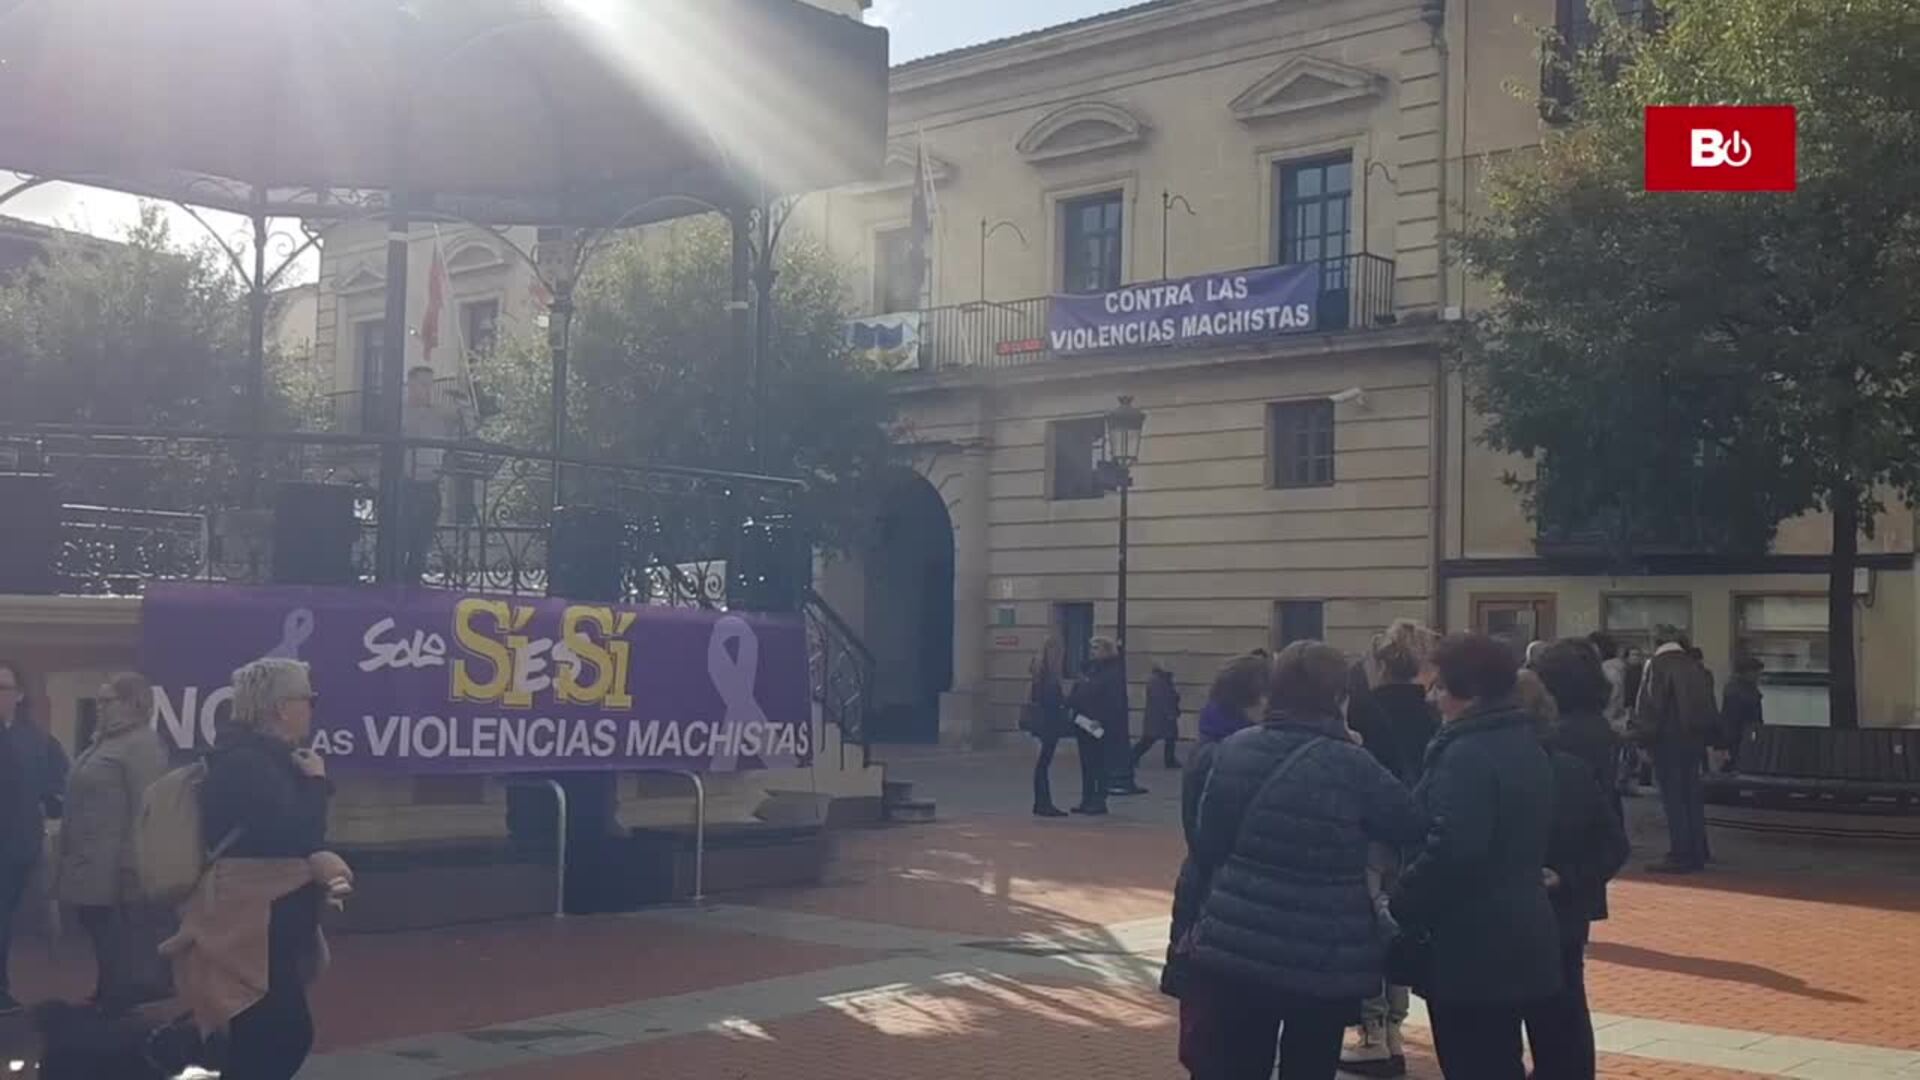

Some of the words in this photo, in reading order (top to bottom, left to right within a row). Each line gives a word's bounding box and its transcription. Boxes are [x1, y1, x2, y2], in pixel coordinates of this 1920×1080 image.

[1105, 283, 1194, 313] CONTRA
[1206, 276, 1248, 301] LAS
[1051, 318, 1175, 350] VIOLENCIAS
[1181, 304, 1310, 338] MACHISTAS
[311, 729, 354, 755] AS
[362, 715, 617, 758] VIOLENCIAS
[625, 720, 810, 757] MACHISTAS
